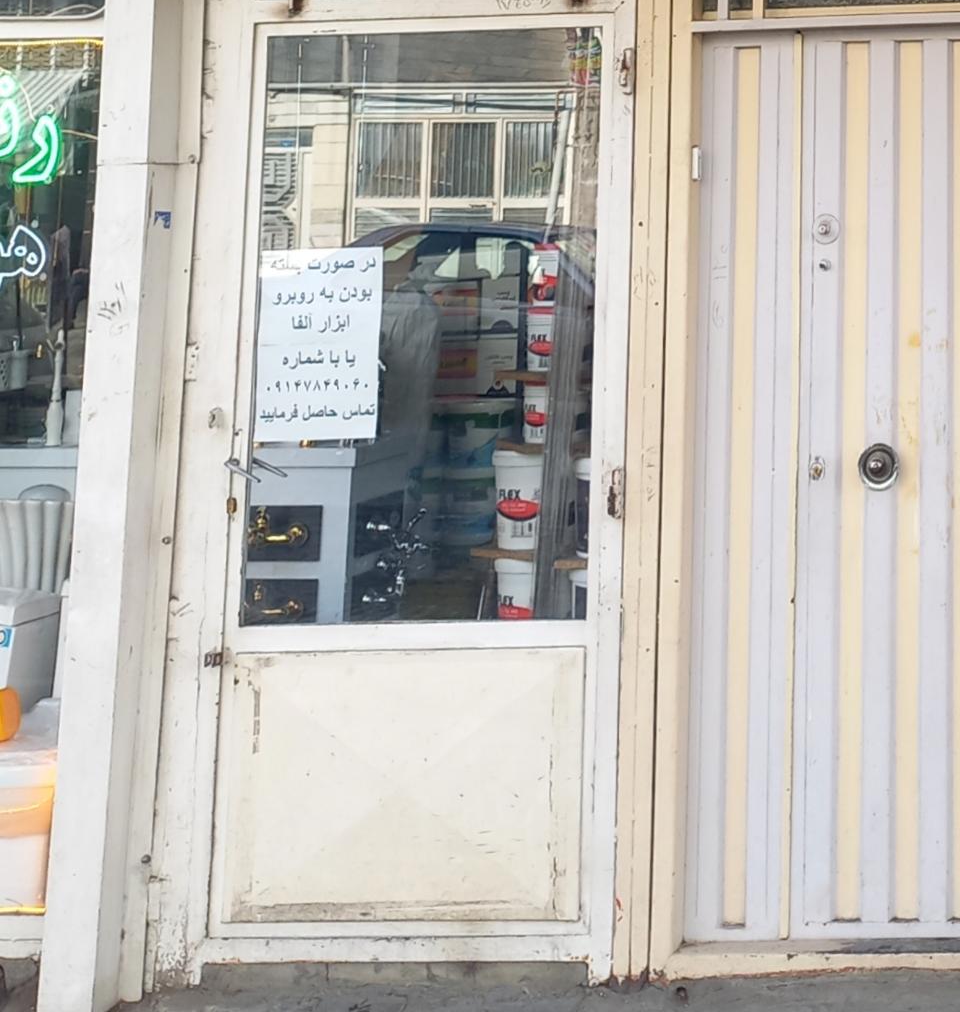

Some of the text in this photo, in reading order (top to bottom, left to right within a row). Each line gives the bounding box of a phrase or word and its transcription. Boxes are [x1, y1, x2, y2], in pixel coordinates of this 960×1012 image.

[307, 260, 355, 274] صورت
[360, 257, 376, 272] در
[272, 286, 372, 305] بودن به روبرو
[318, 314, 350, 333] ابزار
[282, 349, 356, 369] یا با شماره
[266, 380, 369, 393] ۰۹۱۴۷۸۴۹۰۶۰
[259, 403, 376, 424] تماس حاصل فرمایید
